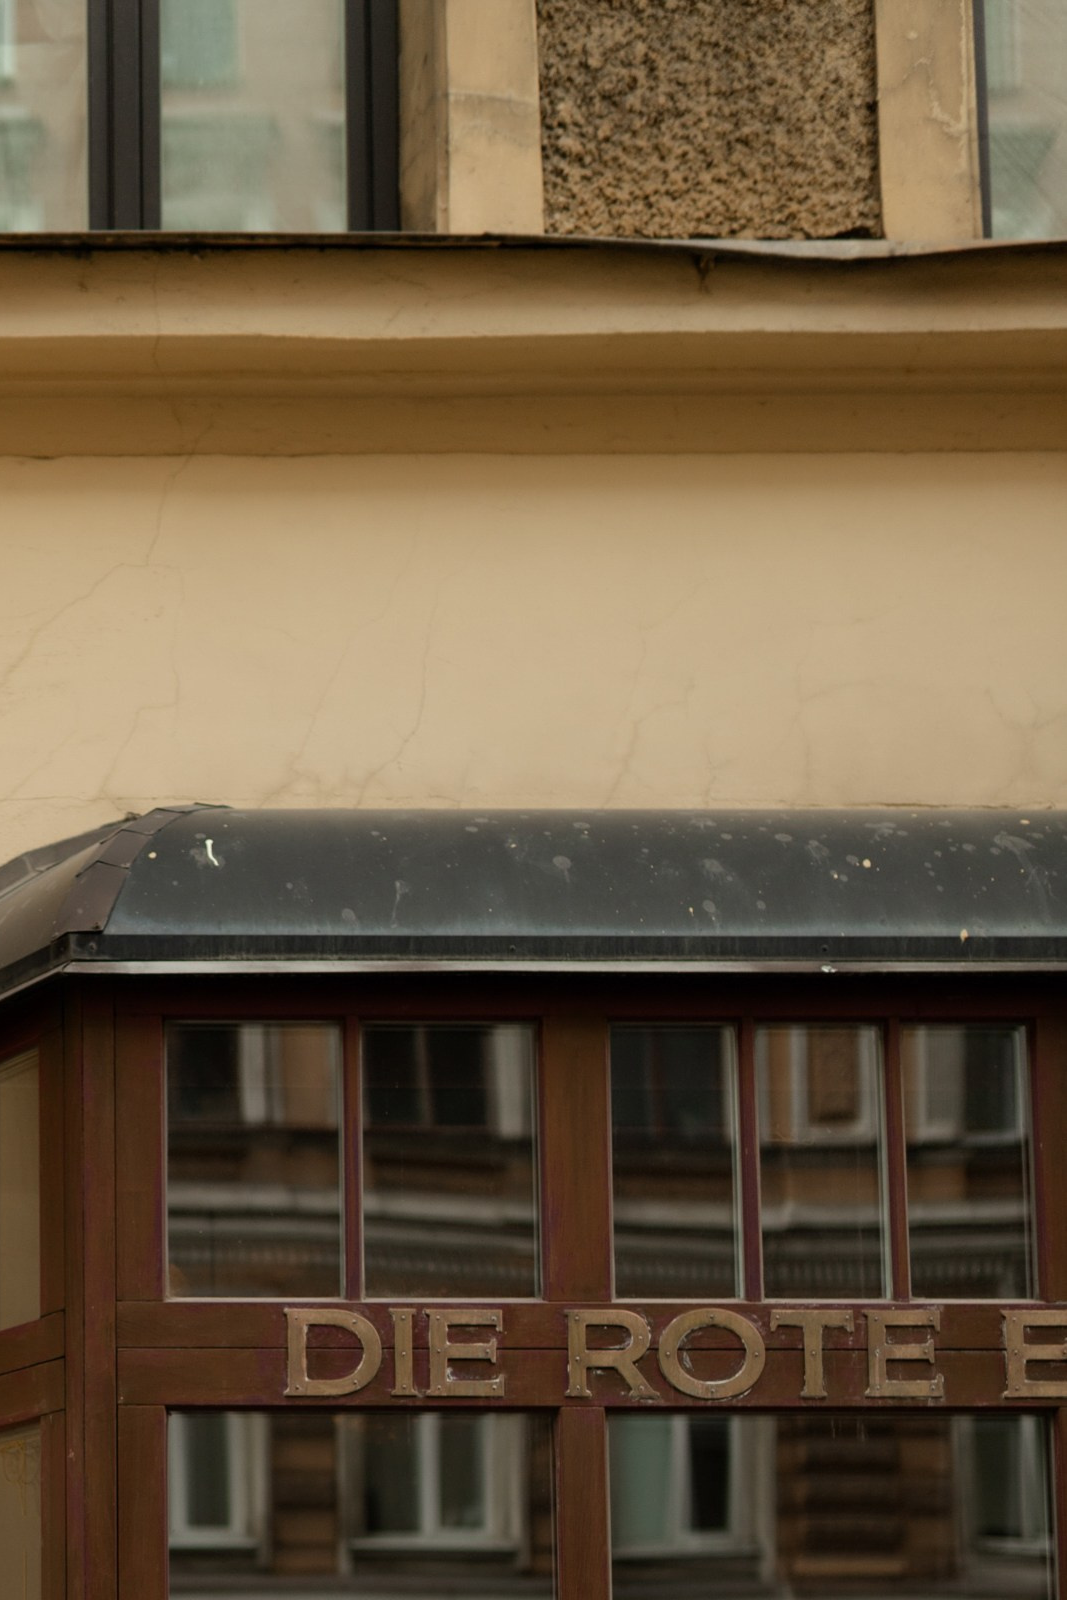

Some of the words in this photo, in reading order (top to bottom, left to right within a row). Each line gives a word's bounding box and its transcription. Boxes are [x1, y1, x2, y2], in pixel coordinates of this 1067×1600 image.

[284, 1308, 505, 1397] DIE
[564, 1308, 944, 1399] ROTE
[1000, 1309, 1067, 1398] E
